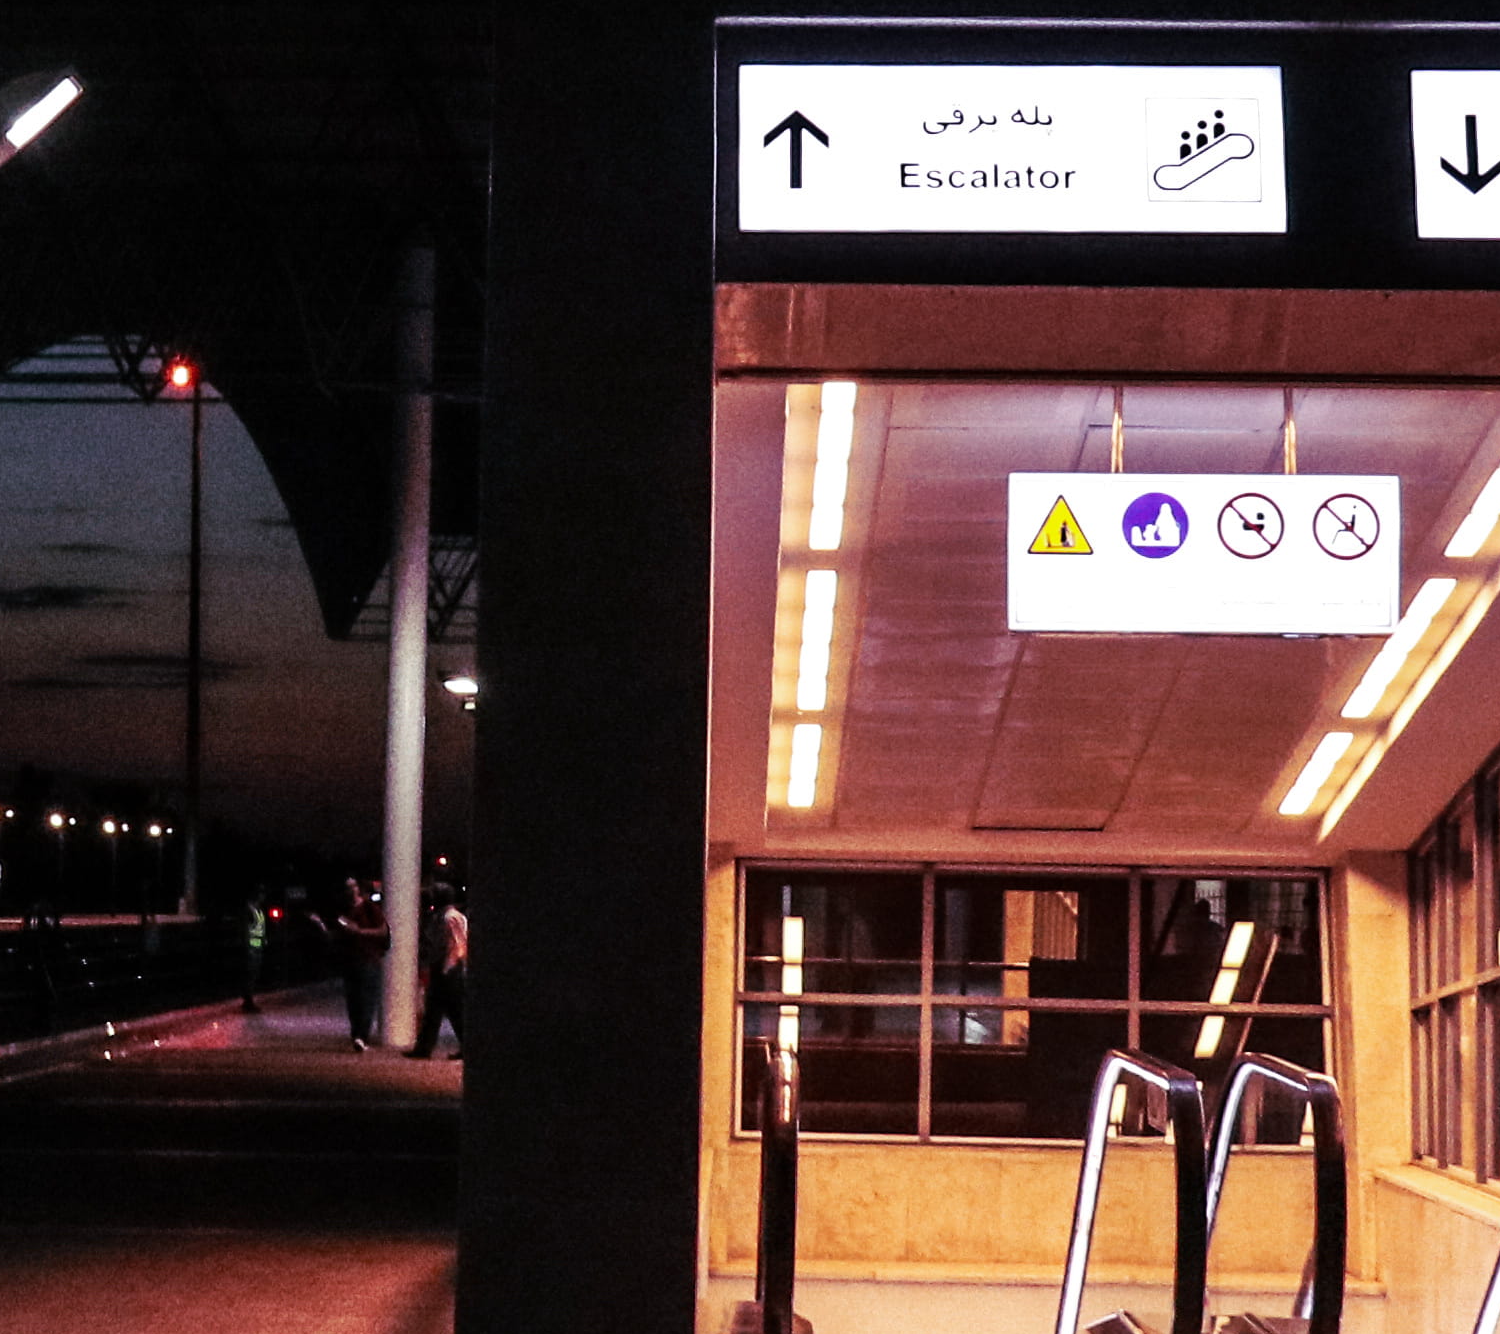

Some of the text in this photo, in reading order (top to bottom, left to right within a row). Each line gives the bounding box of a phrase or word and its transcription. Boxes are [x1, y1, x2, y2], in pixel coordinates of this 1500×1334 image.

[921, 103, 1056, 137] پله برقی
[899, 162, 1077, 190] Escalator
